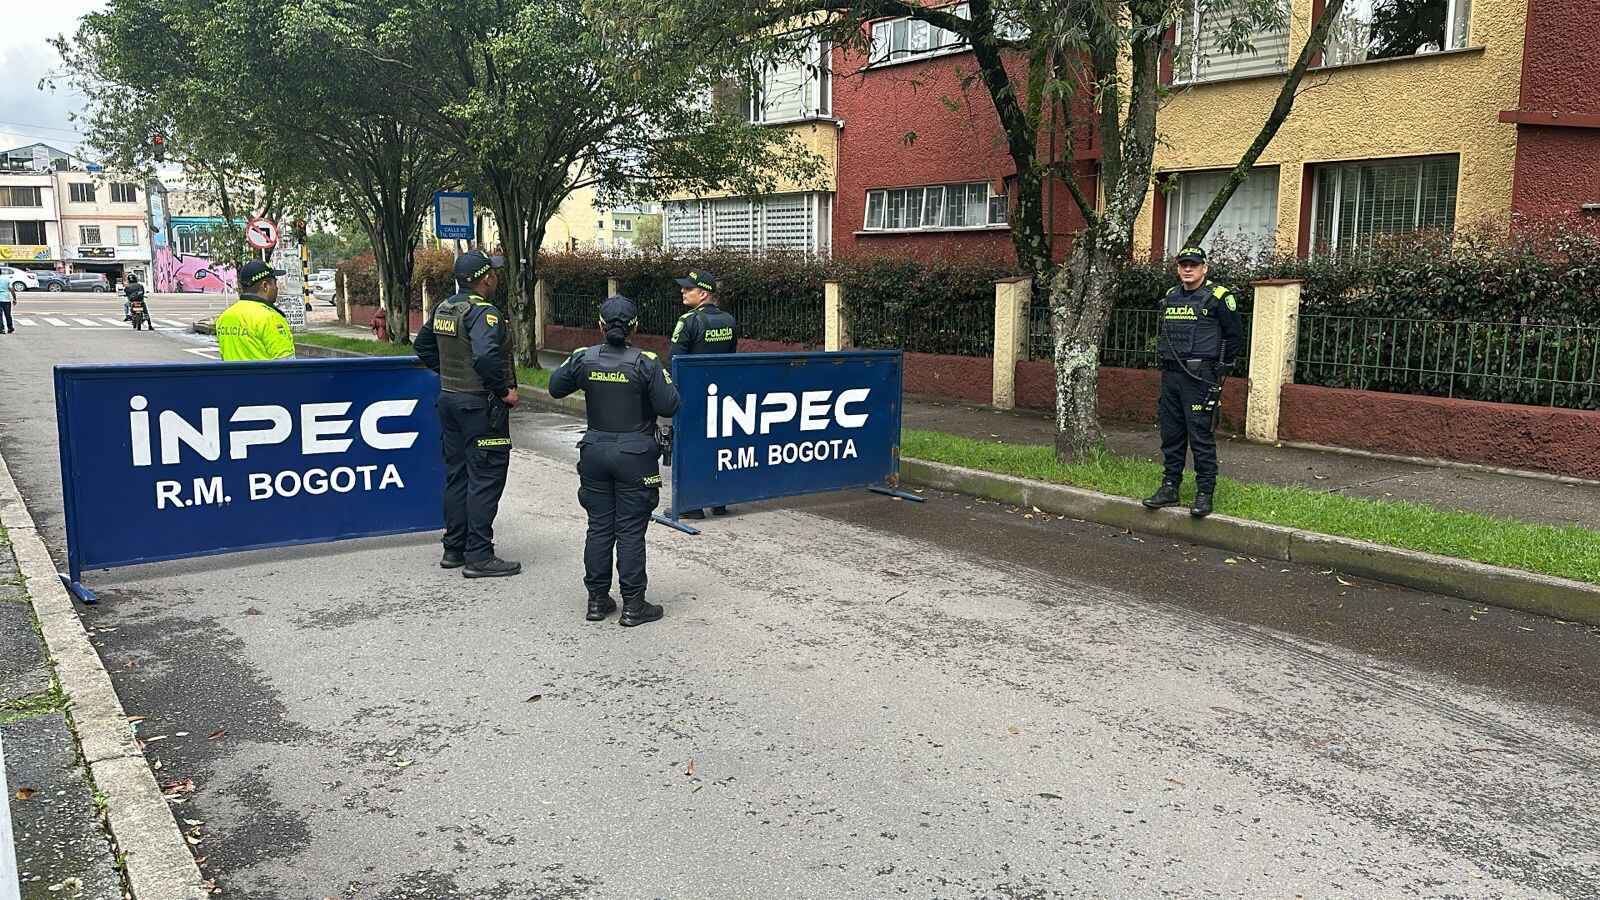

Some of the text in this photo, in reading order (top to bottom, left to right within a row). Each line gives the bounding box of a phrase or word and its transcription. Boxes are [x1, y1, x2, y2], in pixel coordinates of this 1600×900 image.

[591, 371, 626, 380] POLICÍA
[717, 439, 858, 471] R.M. BOGOTA
[156, 464, 405, 509] R.M. BOGOTA
